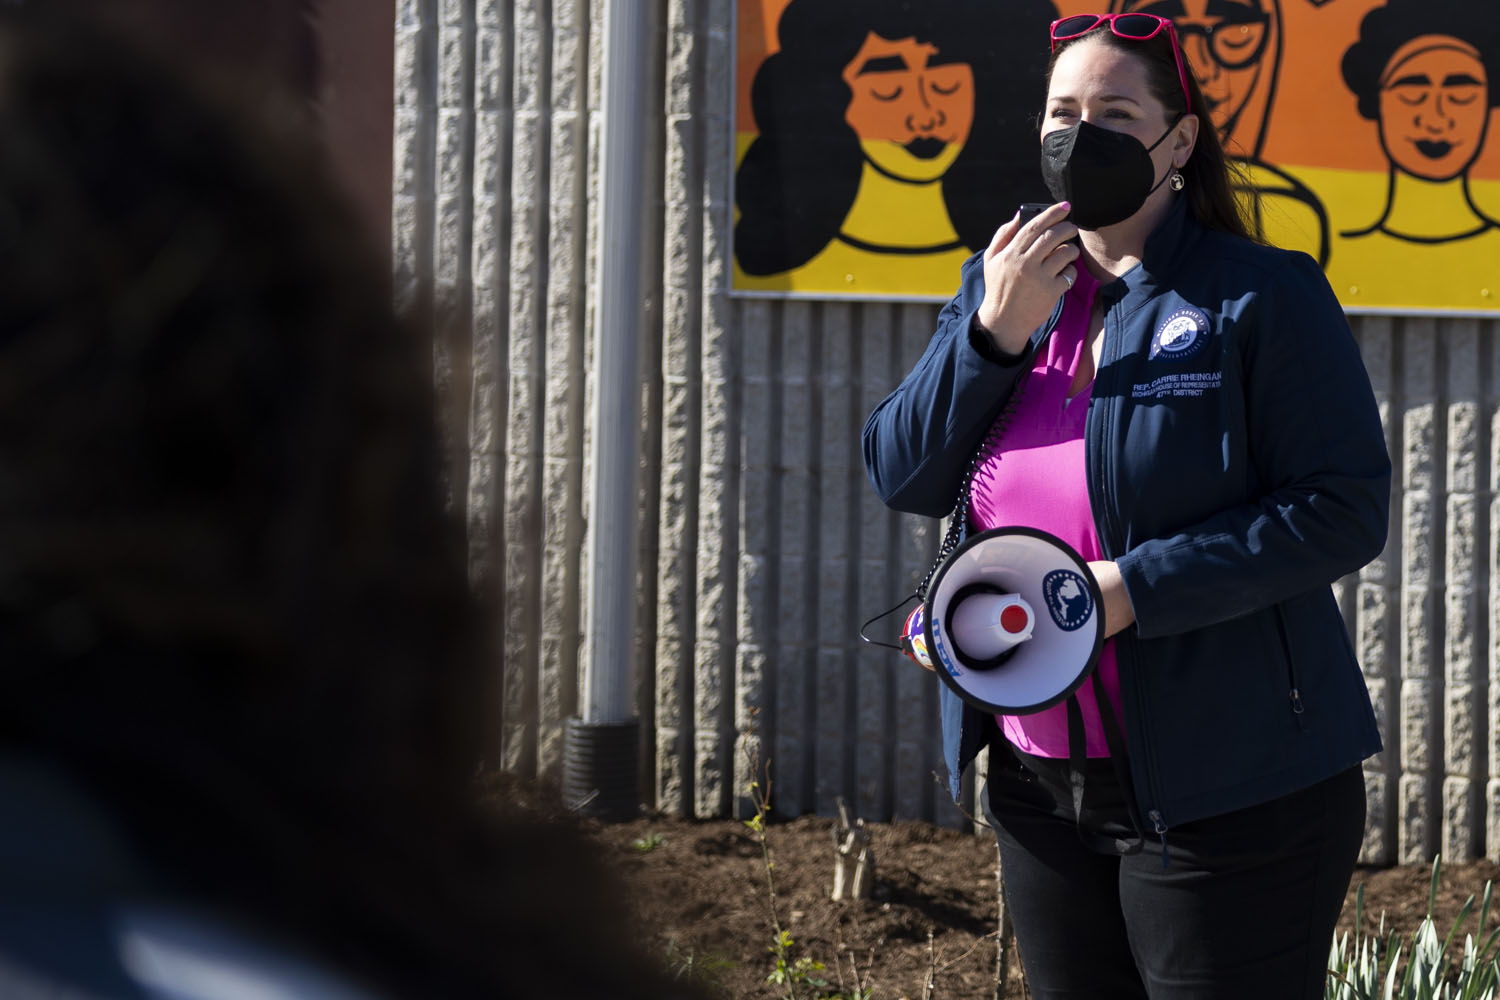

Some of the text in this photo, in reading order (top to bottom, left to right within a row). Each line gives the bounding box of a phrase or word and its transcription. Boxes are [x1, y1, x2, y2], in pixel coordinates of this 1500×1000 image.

[1151, 374, 1180, 387] CARRIE
[1156, 383, 1173, 391] HOUSE
[1173, 389, 1204, 397] DISTRICT
[932, 618, 961, 677] ACLU
